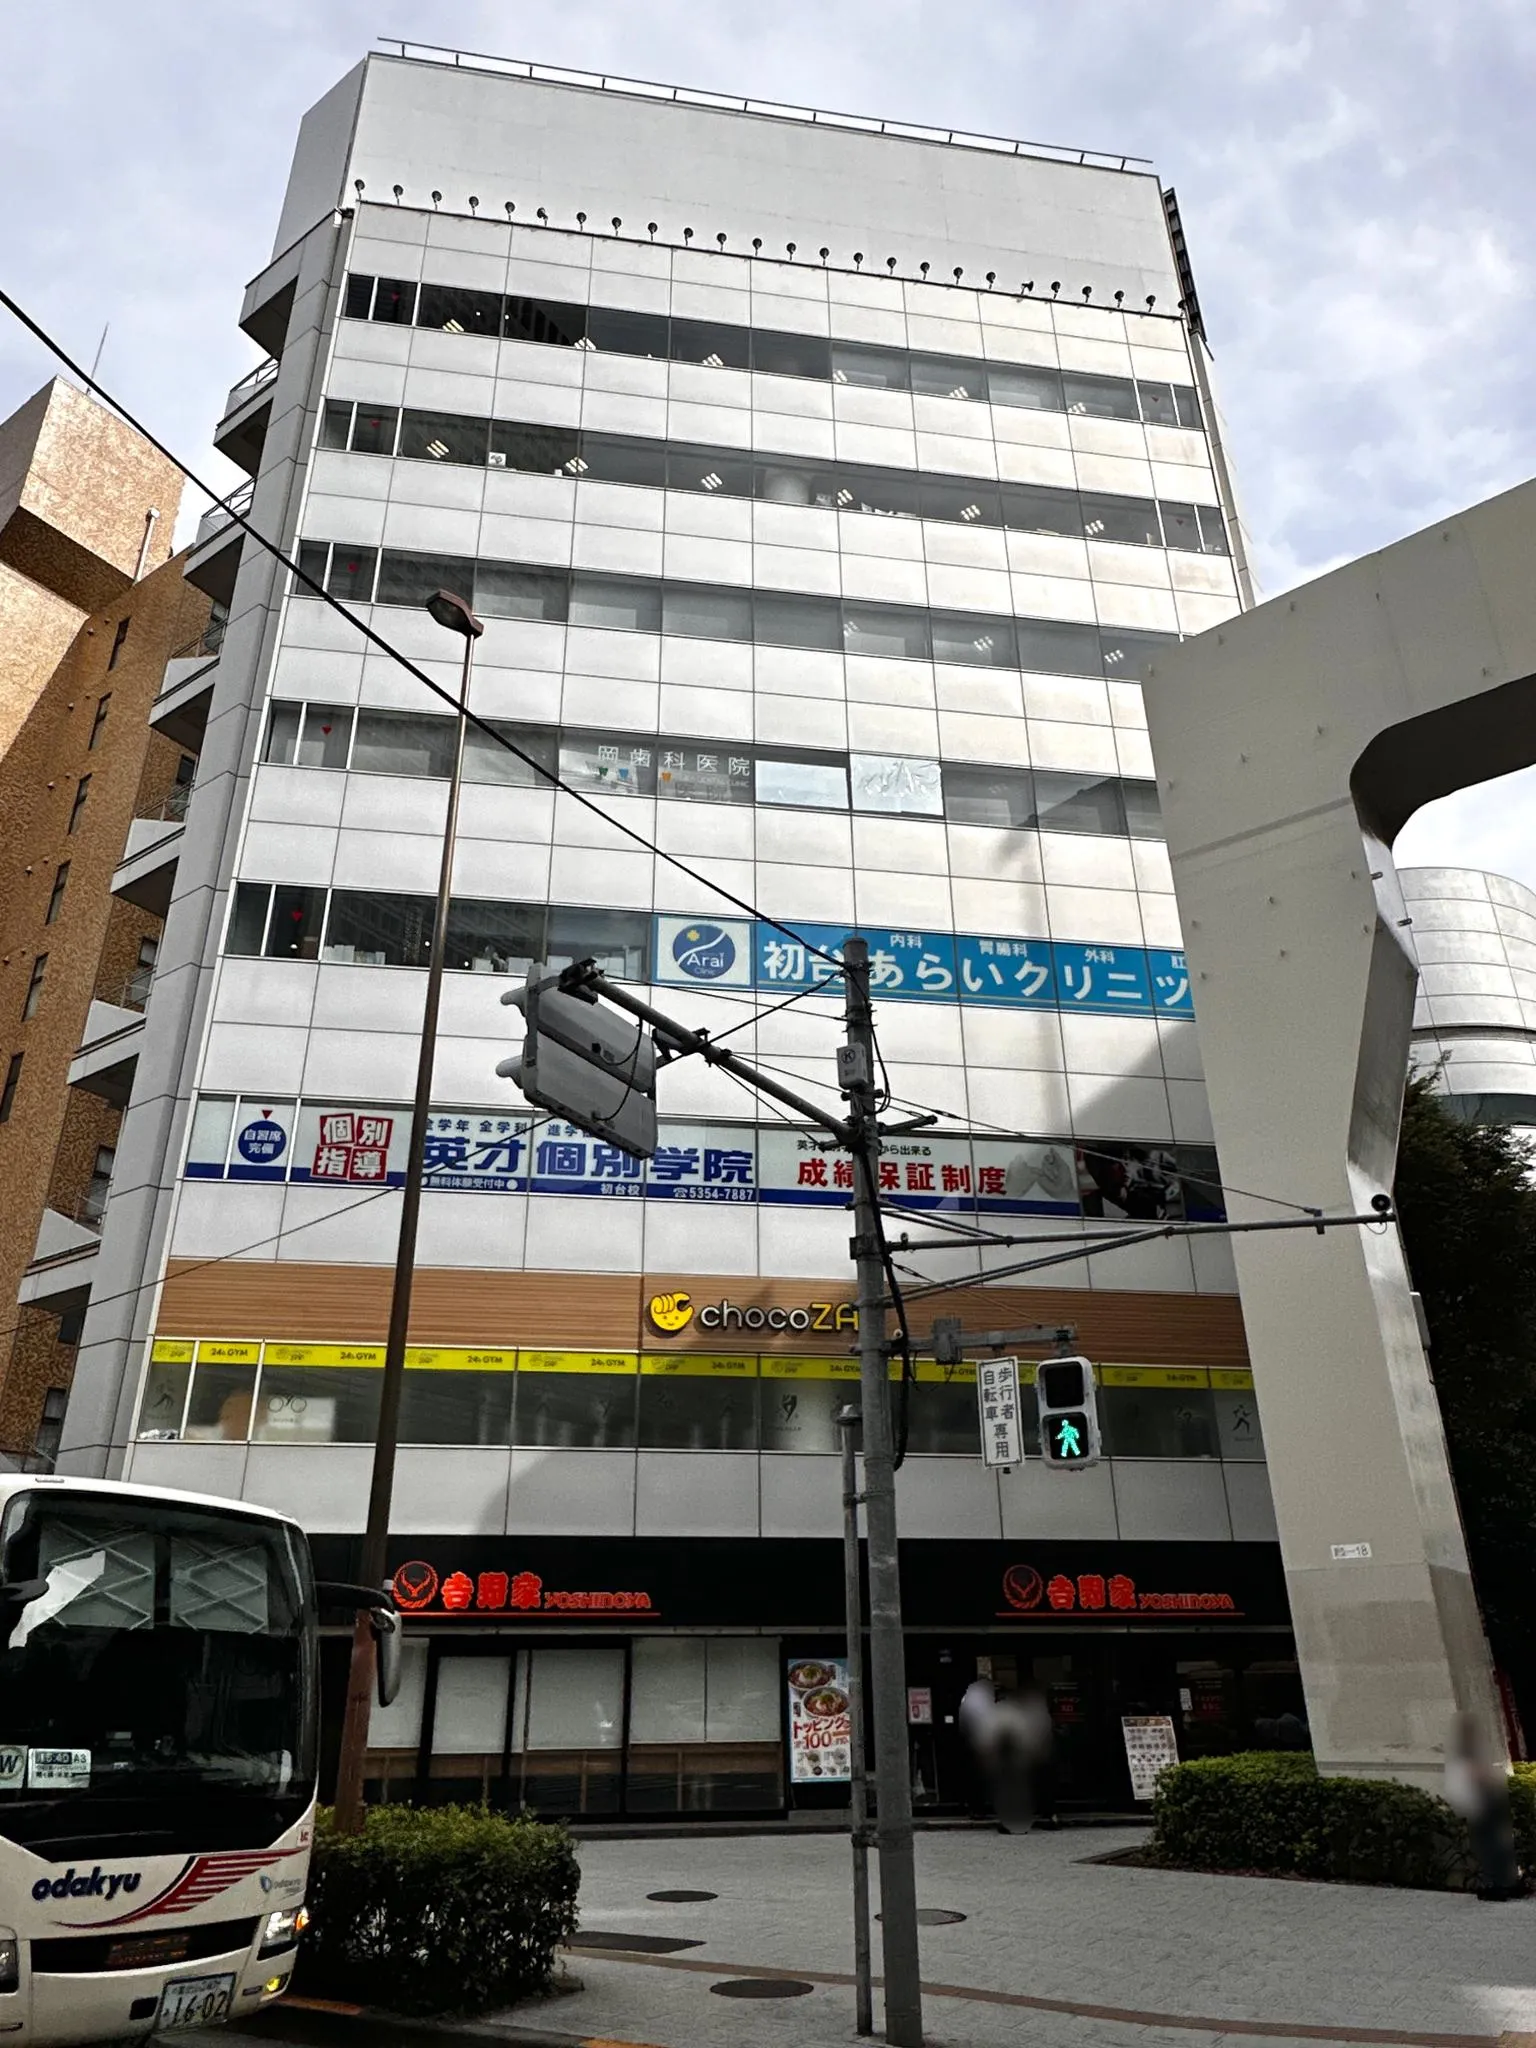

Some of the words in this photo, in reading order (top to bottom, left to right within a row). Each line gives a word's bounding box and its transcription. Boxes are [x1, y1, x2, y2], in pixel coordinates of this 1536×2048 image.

[686, 952, 725, 968] Arai
[890, 934, 922, 948] 内科
[979, 940, 1028, 957] 胃腸科
[1084, 949, 1115, 964] 外科
[323, 1116, 388, 1147] 個別
[317, 1148, 382, 1178] 指導
[422, 1135, 754, 1184] 英才個別学院
[600, 1183, 641, 1196] 初台校
[689, 1188, 754, 1200] 5354-7887
[227, 1348, 248, 1357] GYM
[356, 1352, 377, 1361] GYM
[983, 1370, 999, 1421] 自転車
[999, 1367, 1015, 1420] 歩行者
[994, 1423, 1009, 1459] 専用
[544, 1592, 652, 1609] YOSHINOYA
[1140, 1593, 1235, 1609] YOSHINOYA
[74, 1754, 87, 1764] A3
[32, 1867, 142, 1901] odakyu
[172, 1990, 231, 2024] 16-02
